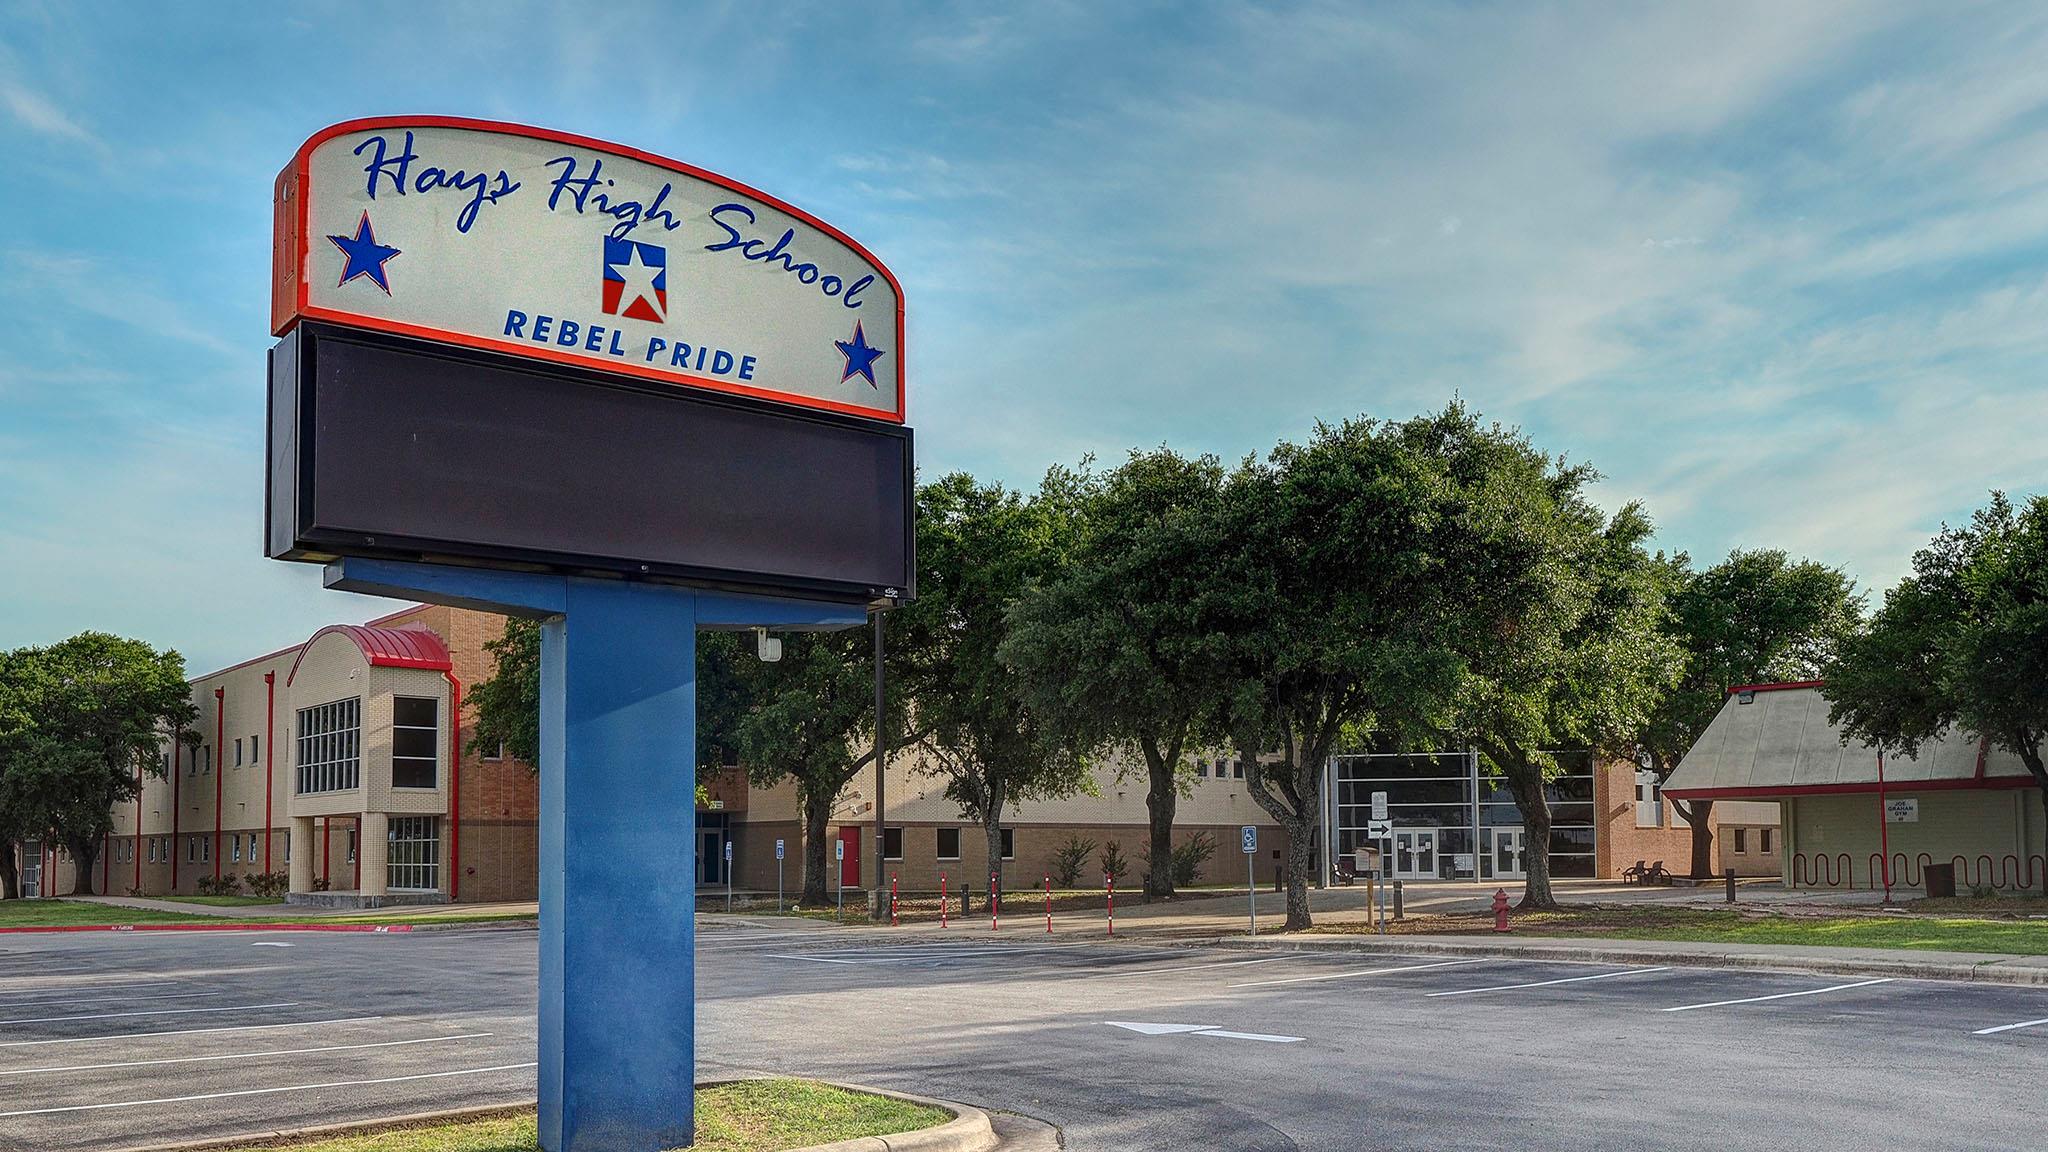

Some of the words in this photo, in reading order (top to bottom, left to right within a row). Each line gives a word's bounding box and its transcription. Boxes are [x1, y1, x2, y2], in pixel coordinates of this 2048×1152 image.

[354, 131, 521, 234] Hays
[545, 157, 681, 242] High
[704, 203, 874, 308] School
[503, 309, 624, 356] REBEL
[645, 337, 757, 380] PRIDE
